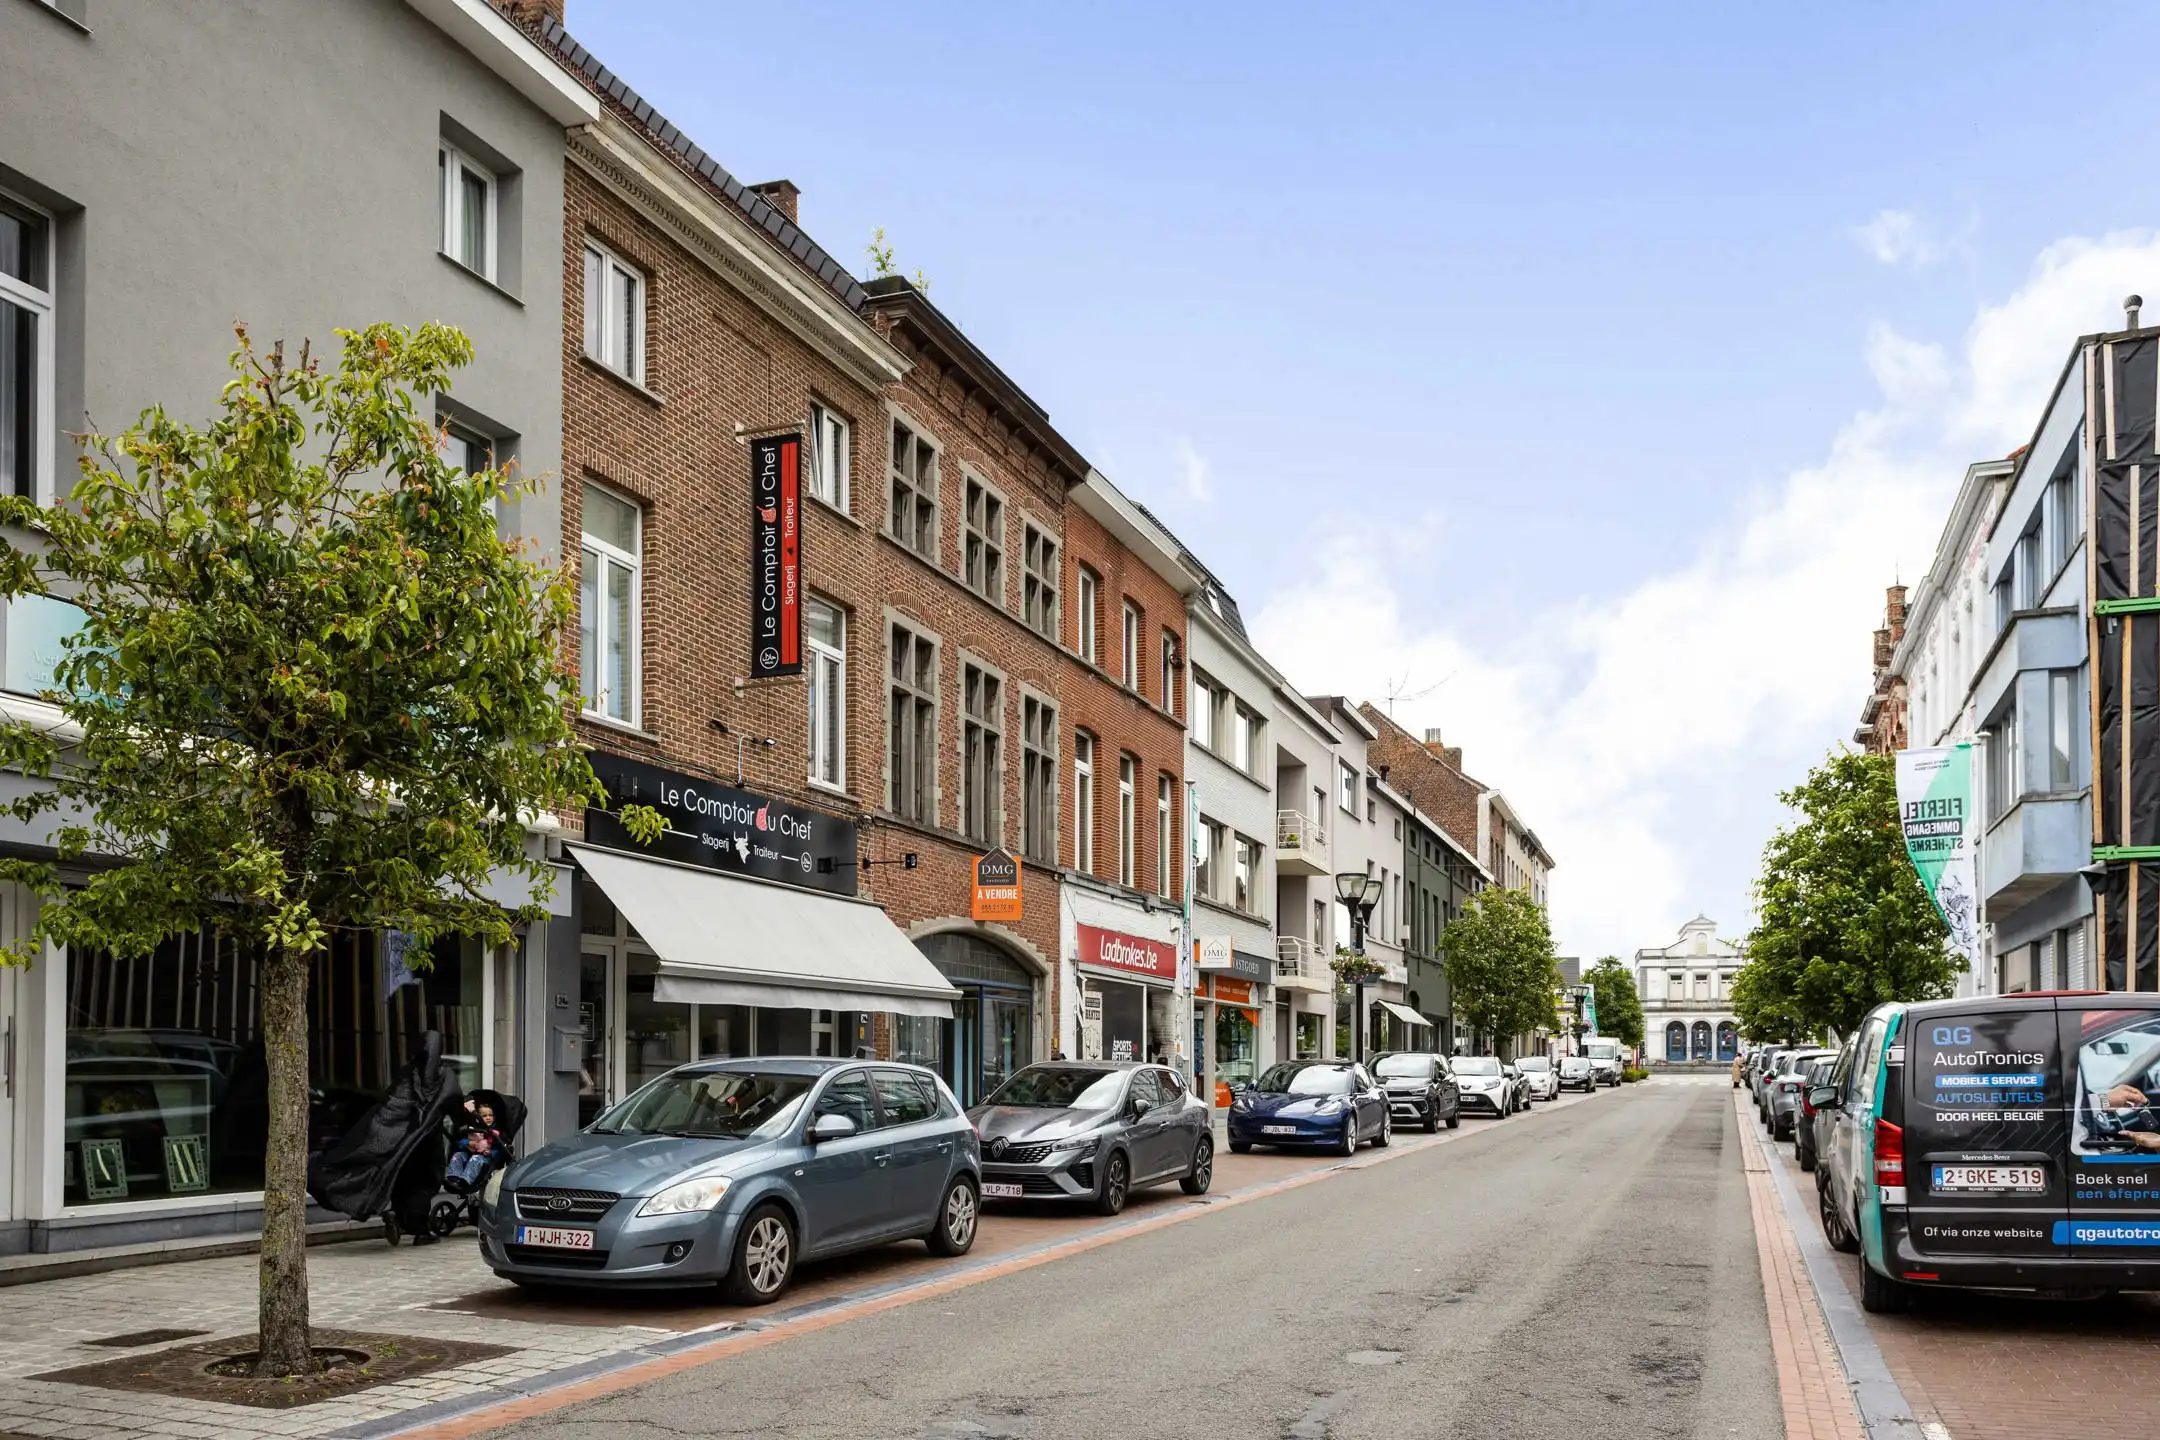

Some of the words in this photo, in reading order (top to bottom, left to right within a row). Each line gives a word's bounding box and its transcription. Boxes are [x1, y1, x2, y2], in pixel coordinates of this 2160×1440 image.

[761, 446, 776, 491] Chef
[785, 497, 794, 538] Traiteur
[762, 525, 779, 616] Comptoir
[785, 565, 796, 605] Slagerij
[762, 616, 776, 638] Le
[660, 782, 679, 806] Le
[684, 788, 756, 826] Comptoir
[780, 814, 812, 840] Chef
[702, 833, 730, 852] Slagerij
[754, 844, 779, 861] Traiteur
[982, 864, 1014, 874] DMG
[986, 889, 1018, 900] VENDRE
[1100, 935, 1158, 970] Ladbrokes.be
[1204, 949, 1228, 958] DMG
[1932, 1026, 1972, 1046] QG
[1112, 1040, 1132, 1051] SPORTS
[1934, 1050, 2044, 1066] AutoTronics
[1942, 1076, 1989, 1085] MOBIELE
[1992, 1076, 2037, 1085] SERVICE
[1936, 1092, 2044, 1104] AUTOSLEUTELS
[1936, 1112, 1969, 1121] DOOR
[1972, 1112, 2001, 1121] HEEL
[2004, 1110, 2044, 1121] BELGIË
[2076, 1174, 2113, 1184] Boek
[2117, 1174, 2148, 1184] snel
[2076, 1190, 2103, 1199] een
[552, 1199, 568, 1207] KIA
[527, 1230, 590, 1247] 1-WJH-322
[1924, 1227, 1938, 1237] Of
[1941, 1227, 1958, 1237] via
[1962, 1229, 1990, 1237] onze
[1994, 1227, 2043, 1238] website
